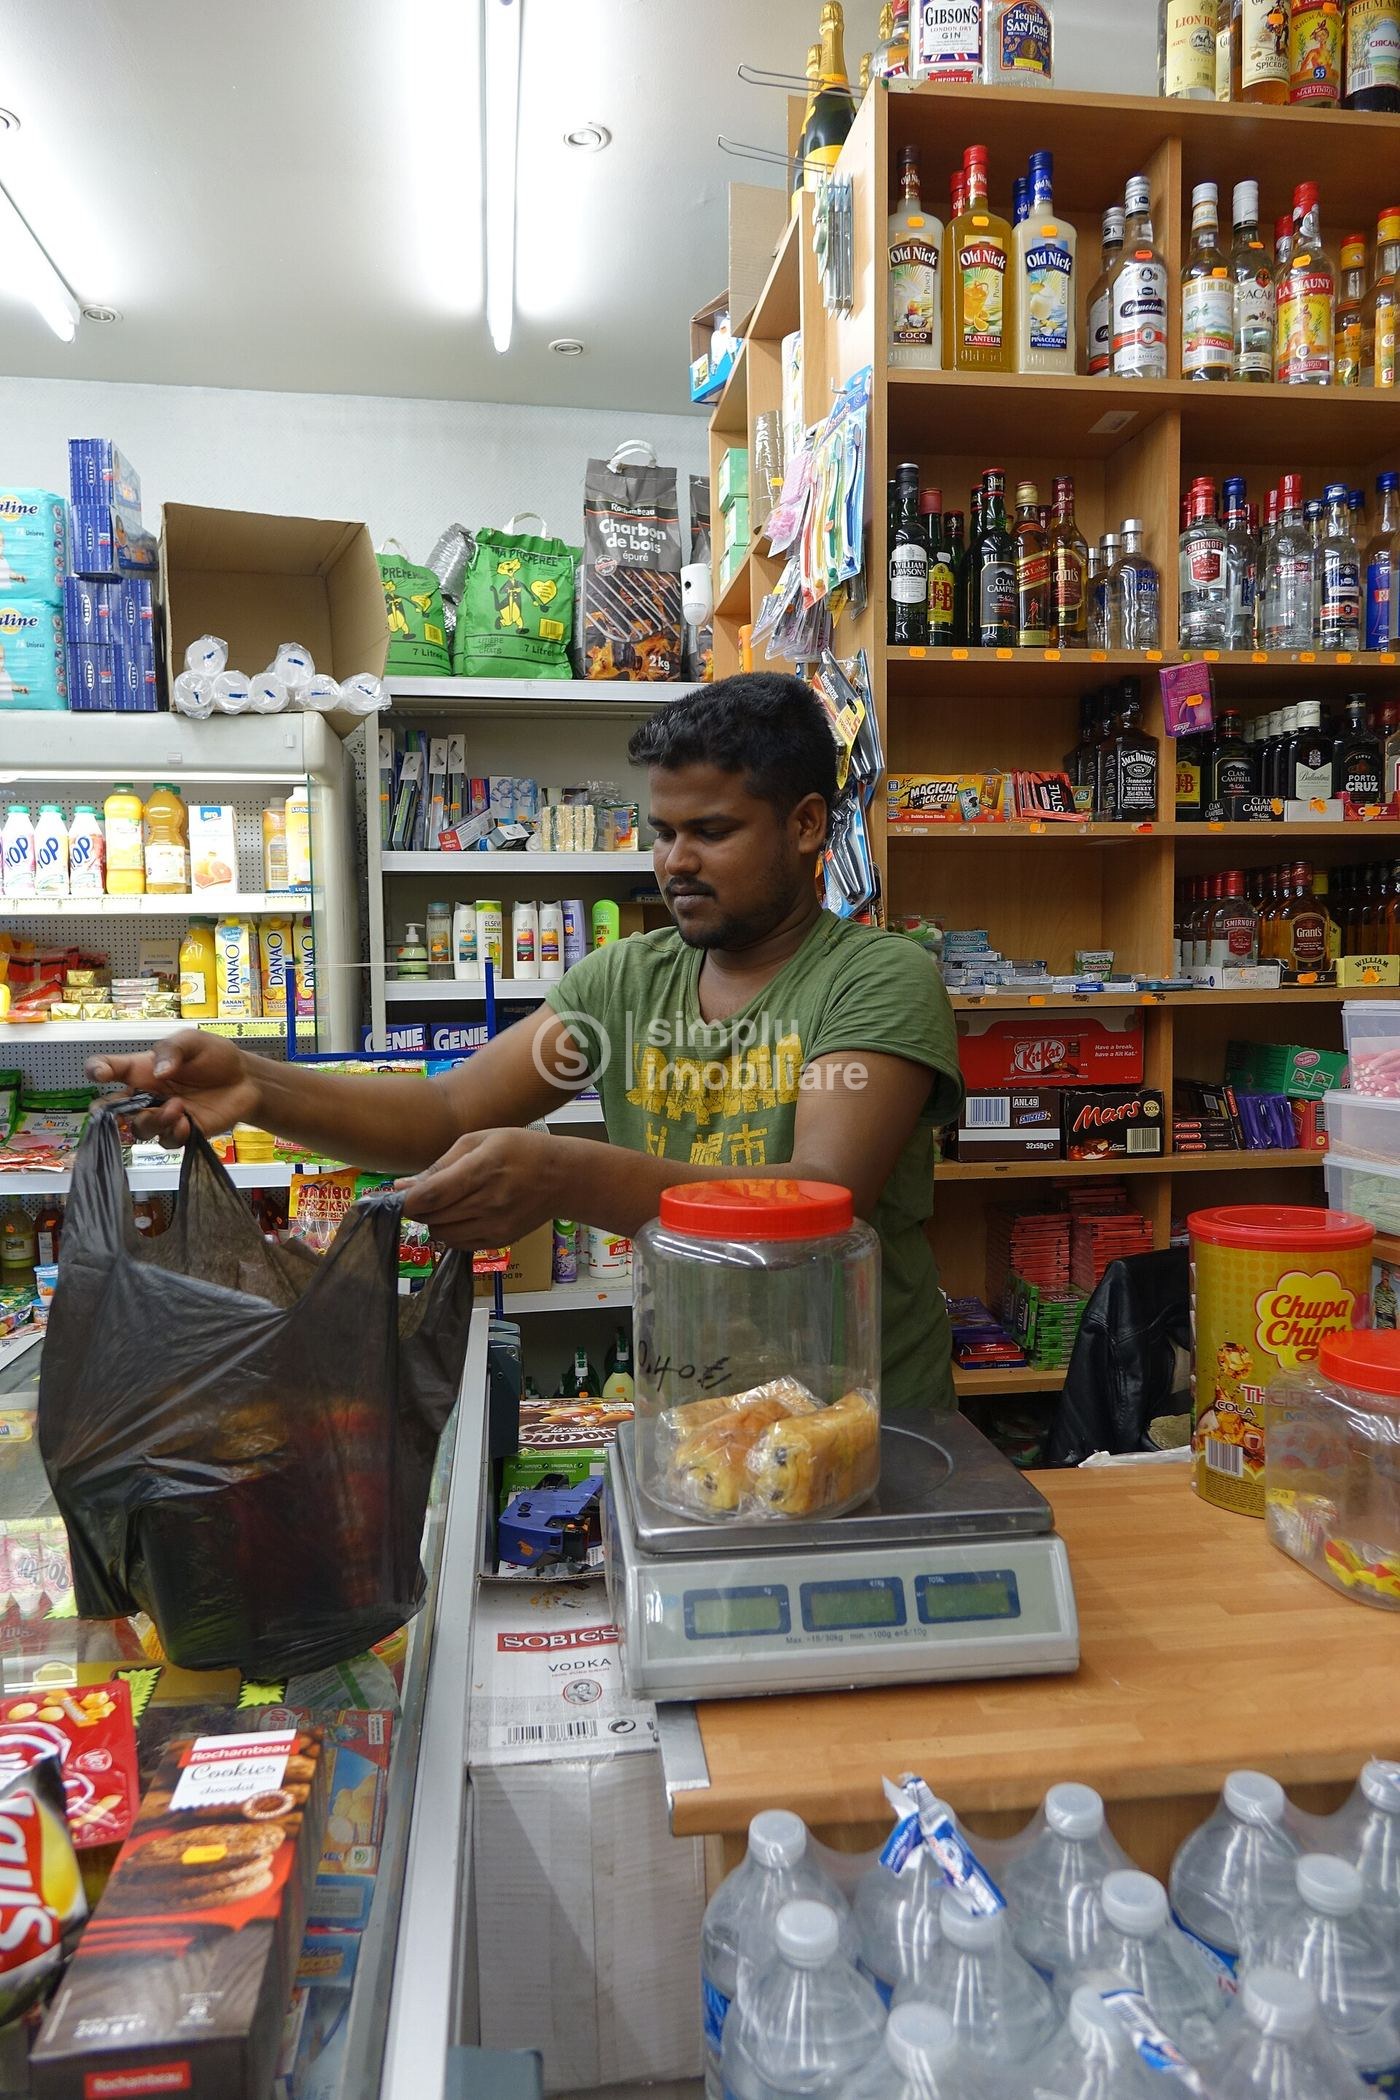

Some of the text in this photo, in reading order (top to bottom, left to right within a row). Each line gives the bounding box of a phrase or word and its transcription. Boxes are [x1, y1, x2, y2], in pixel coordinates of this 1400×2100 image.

[925, 6, 978, 26] GIBSON'S
[1012, 10, 1044, 26] Tequila
[1175, 14, 1200, 29] LION
[1006, 18, 1048, 38] SAN JOSÉ
[942, 32, 962, 40] GIN
[1315, 68, 1325, 80] 55
[890, 246, 938, 266] Old Nick
[960, 248, 1006, 270] Old Nick
[1026, 250, 1072, 271] Old Nick
[1278, 286, 1288, 300] LA
[900, 332, 928, 340] COCO
[964, 335, 1001, 343] PLANTEUR
[599, 518, 666, 540] Charbon
[606, 532, 661, 554] de bois
[1187, 540, 1224, 554] SMIRNOFF
[622, 551, 648, 562] épuré
[894, 561, 924, 570] WILLIAM
[649, 656, 670, 670] 2 kg
[1120, 754, 1135, 766] JACK
[1348, 774, 1376, 782] PORTO
[910, 783, 958, 799] MAGICAL
[1346, 782, 1378, 792] CRUZ
[1048, 784, 1064, 812] STYLE
[1226, 920, 1256, 928] SMIRNOFF
[1296, 926, 1323, 938] Grant's
[266, 932, 284, 986] DANAO
[1354, 956, 1389, 968] WILLIAM
[225, 944, 240, 994] DANAO
[434, 1026, 488, 1050] GENIE
[1014, 1098, 1038, 1106] ANL49
[1072, 1100, 1141, 1132] Mars
[298, 1186, 350, 1200] HARIBO
[1271, 1294, 1349, 1326] Chupa
[1216, 1400, 1256, 1418] COLA
[548, 1658, 612, 1672] VODKA
[191, 1743, 292, 1762] Rochambeau
[191, 1762, 276, 1782] Cookies
[94, 2072, 184, 2092] Rochambeau
